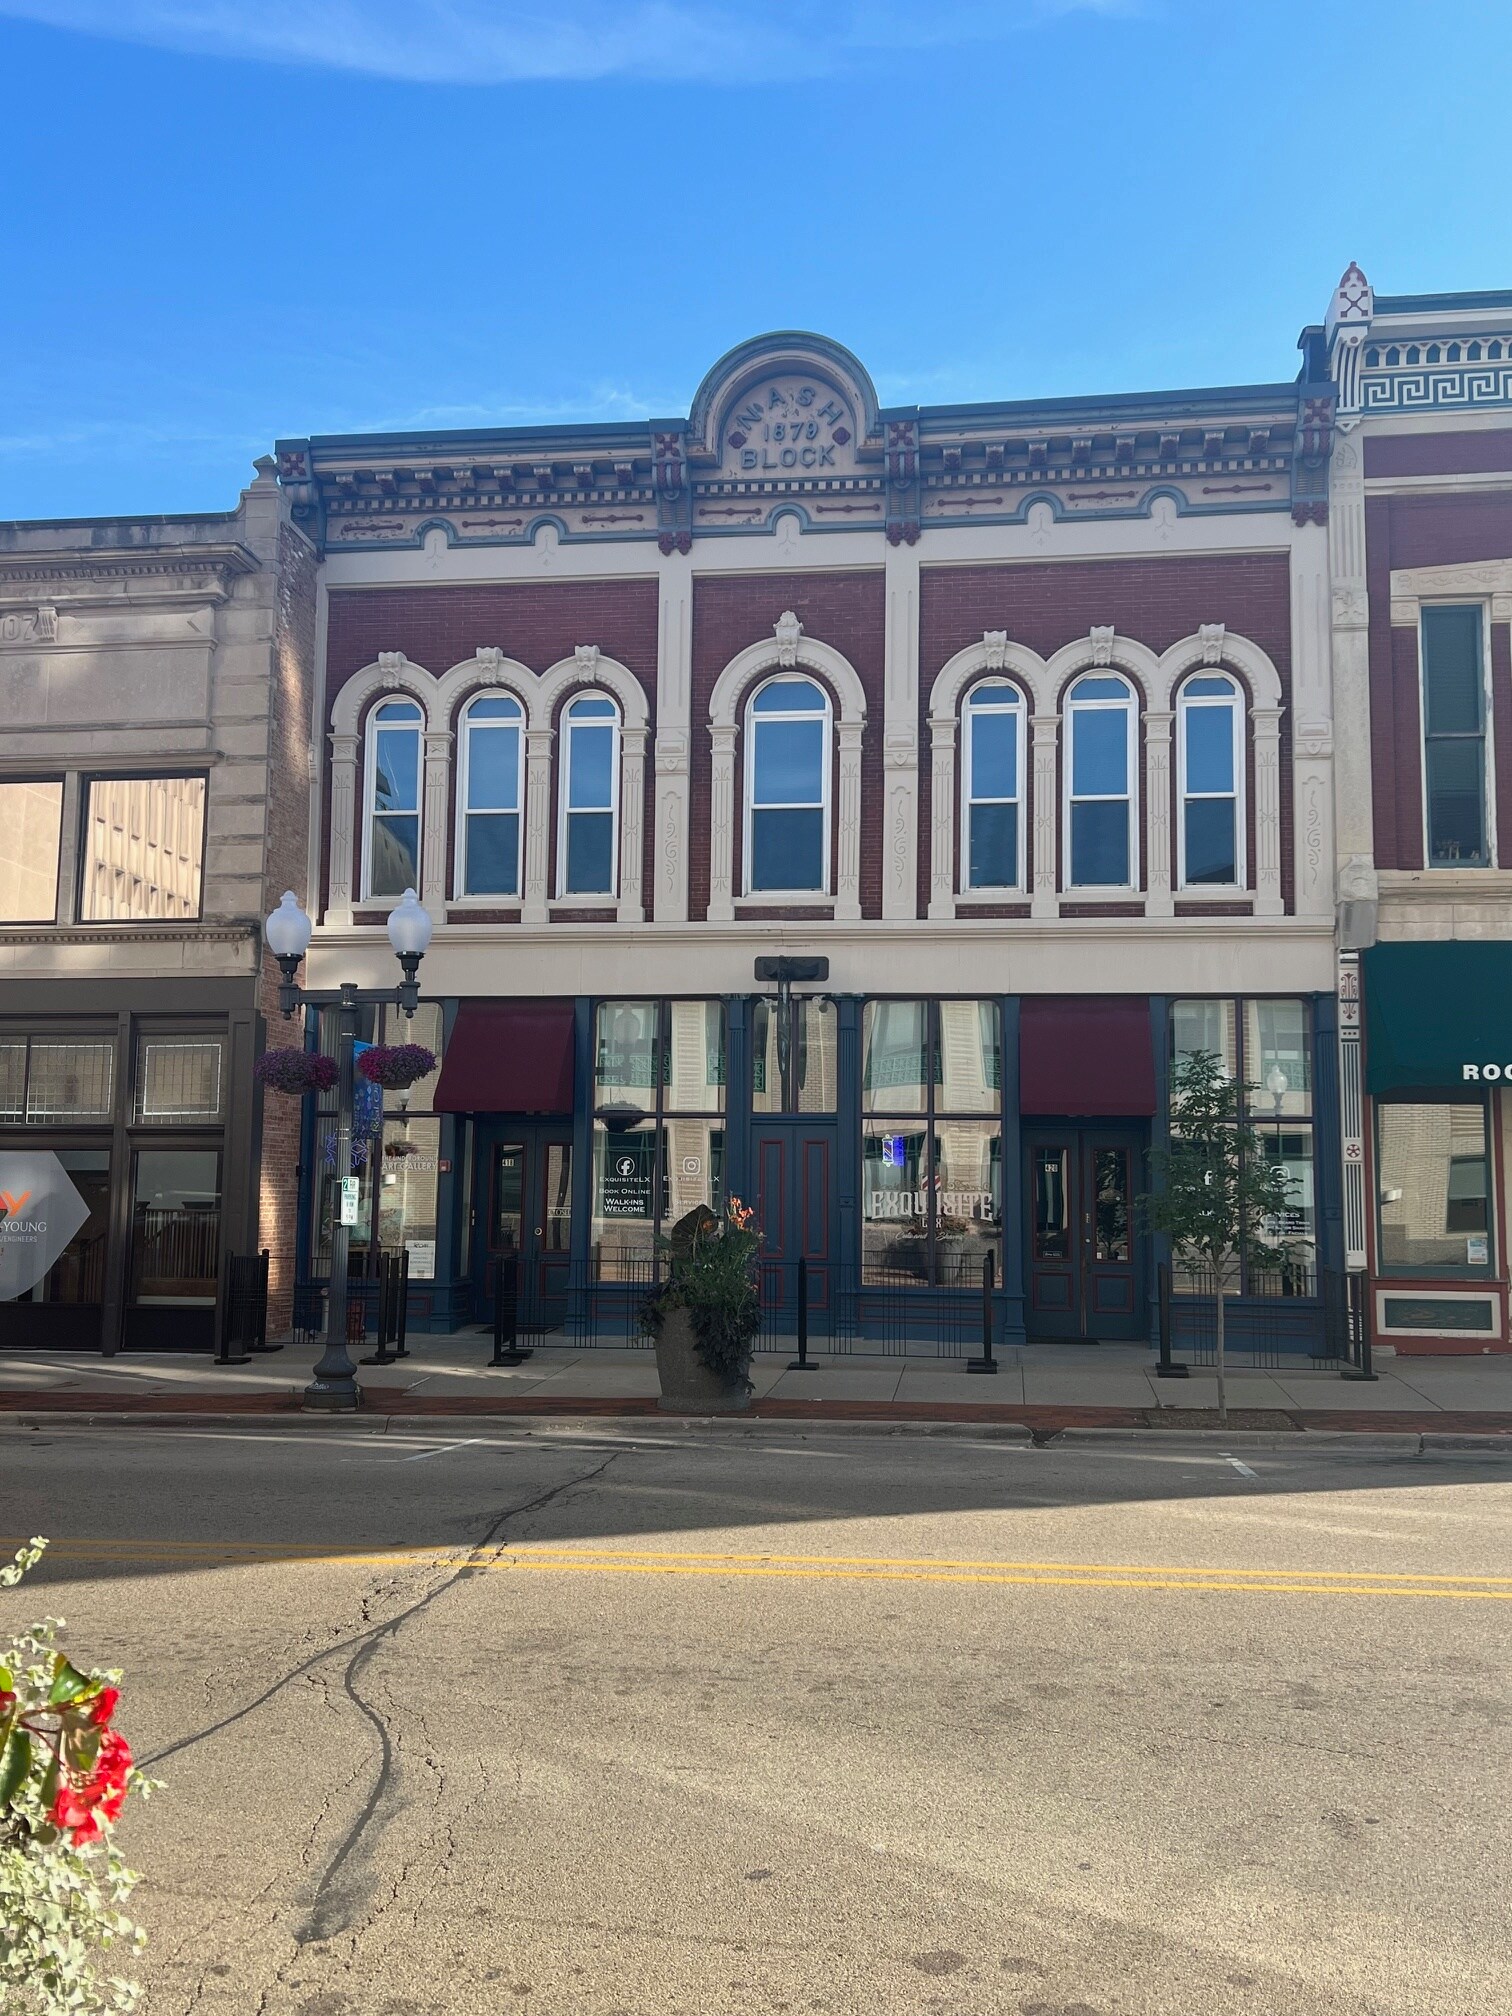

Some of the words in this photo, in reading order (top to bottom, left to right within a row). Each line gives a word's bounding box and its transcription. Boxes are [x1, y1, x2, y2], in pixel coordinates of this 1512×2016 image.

[736, 386, 843, 431] NASH
[764, 421, 819, 442] 1879
[740, 445, 835, 469] BLOCK
[382, 1162, 398, 1170] ART
[399, 1162, 437, 1170] GALLERY
[343, 1178, 348, 1190] 2
[604, 1205, 645, 1213] WELCOME
[871, 1190, 993, 1222] EXQUISITE
